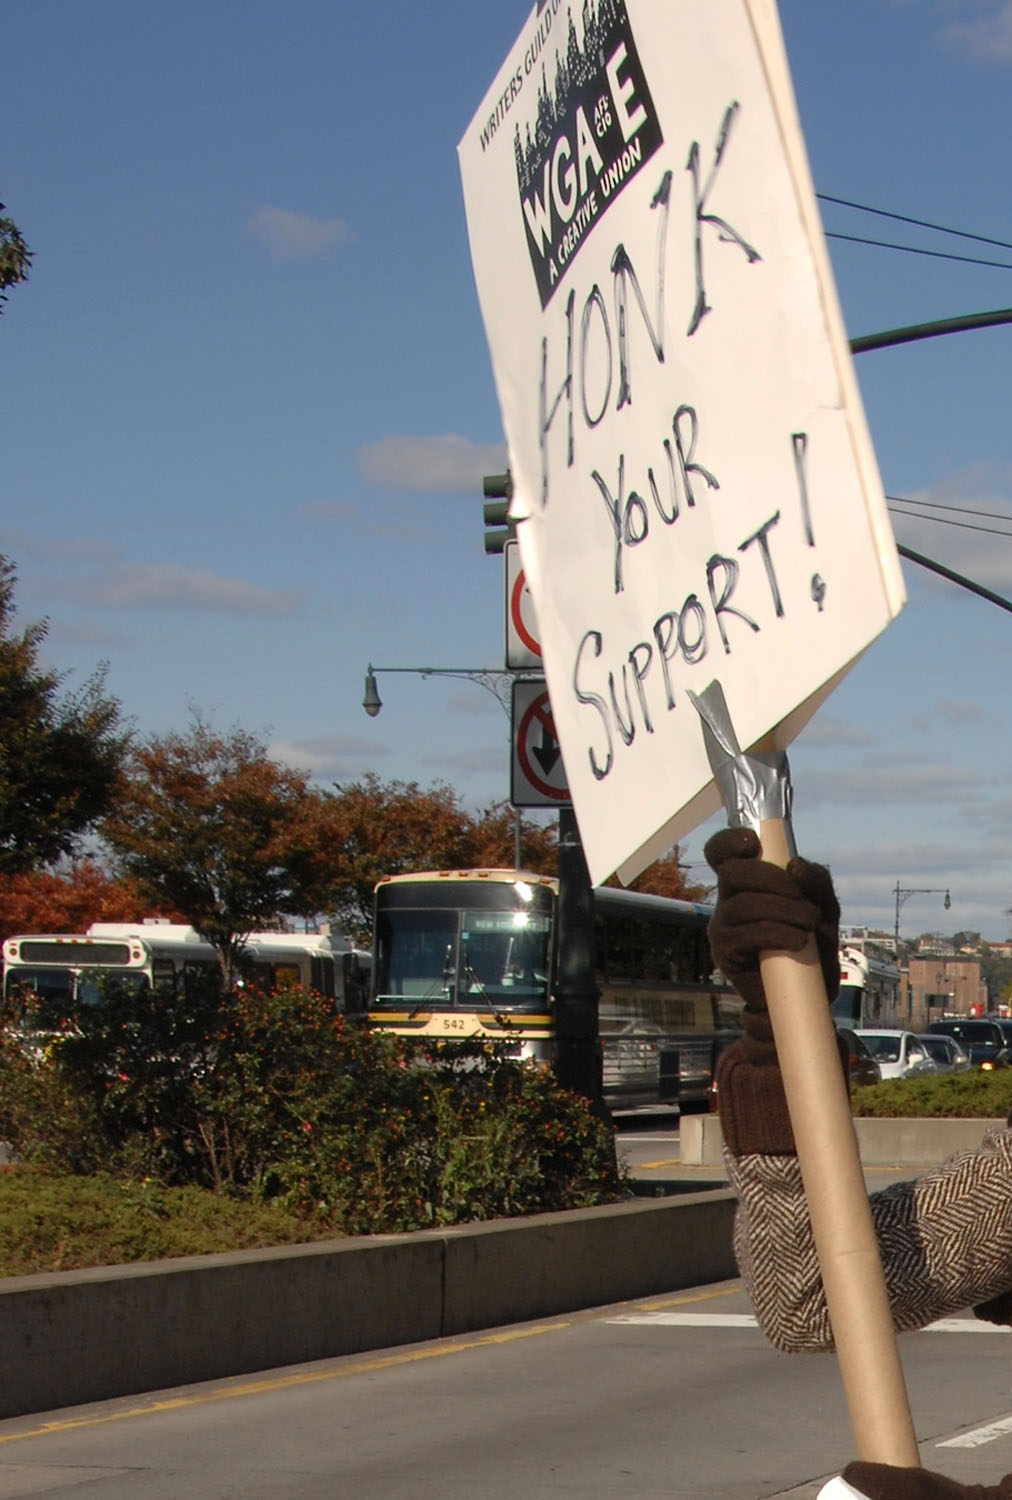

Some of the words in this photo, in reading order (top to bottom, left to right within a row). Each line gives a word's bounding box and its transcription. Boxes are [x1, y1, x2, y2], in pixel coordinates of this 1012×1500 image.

[479, 66, 523, 152] WRITERS
[524, 9, 552, 76] GUILD
[549, 257, 559, 285] A
[558, 190, 599, 265] CREATIVE
[600, 137, 642, 197] UNION
[539, 101, 763, 506] HONK
[590, 404, 720, 594] YOUR
[443, 1019, 465, 1030] 542
